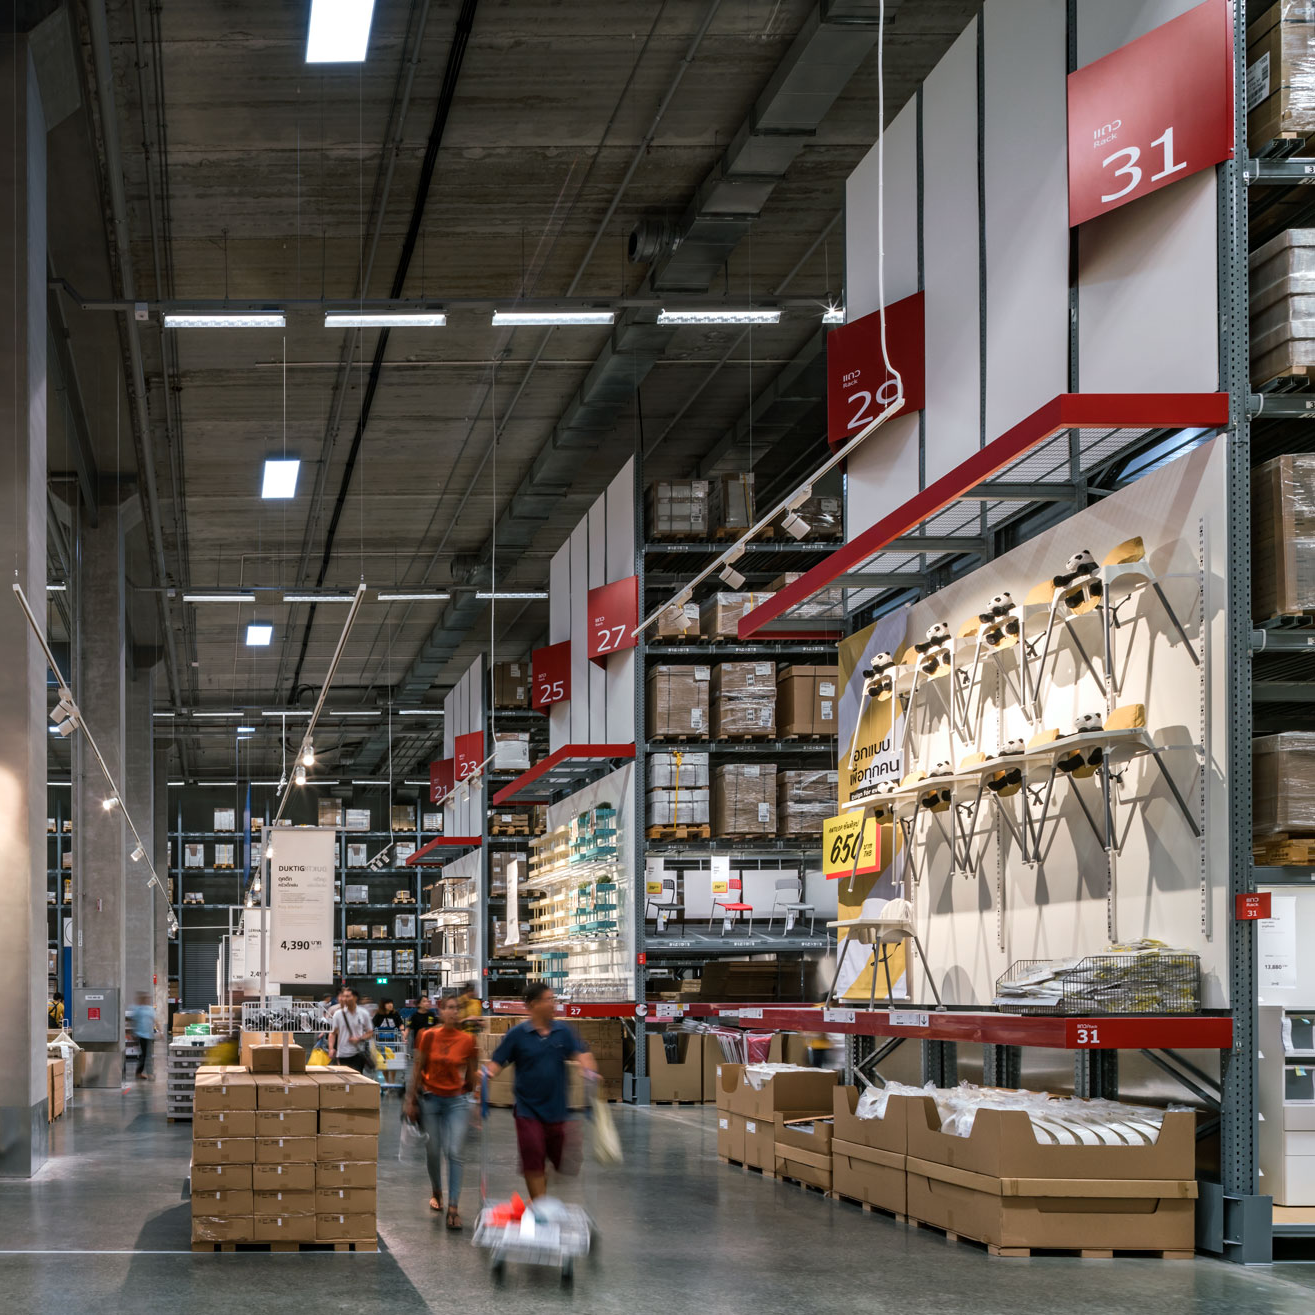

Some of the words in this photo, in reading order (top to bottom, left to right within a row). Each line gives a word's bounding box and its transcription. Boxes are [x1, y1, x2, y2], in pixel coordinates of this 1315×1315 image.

[1093, 119, 1122, 139] แถว
[1093, 132, 1117, 148] Rack
[1101, 127, 1187, 203] 31
[842, 369, 861, 382] แถว
[842, 379, 858, 389] Rack
[847, 379, 904, 430] 29
[597, 624, 626, 652] 27
[540, 680, 564, 703] 25
[850, 739, 890, 762] อกแบบ
[460, 760, 477, 777] 23
[850, 759, 900, 786] เพื่อทุกคน
[434, 785, 448, 799] 21
[830, 831, 864, 864] 650
[1247, 909, 1257, 917] 31
[280, 940, 310, 951] 4,390
[1077, 1029, 1100, 1044] 31
